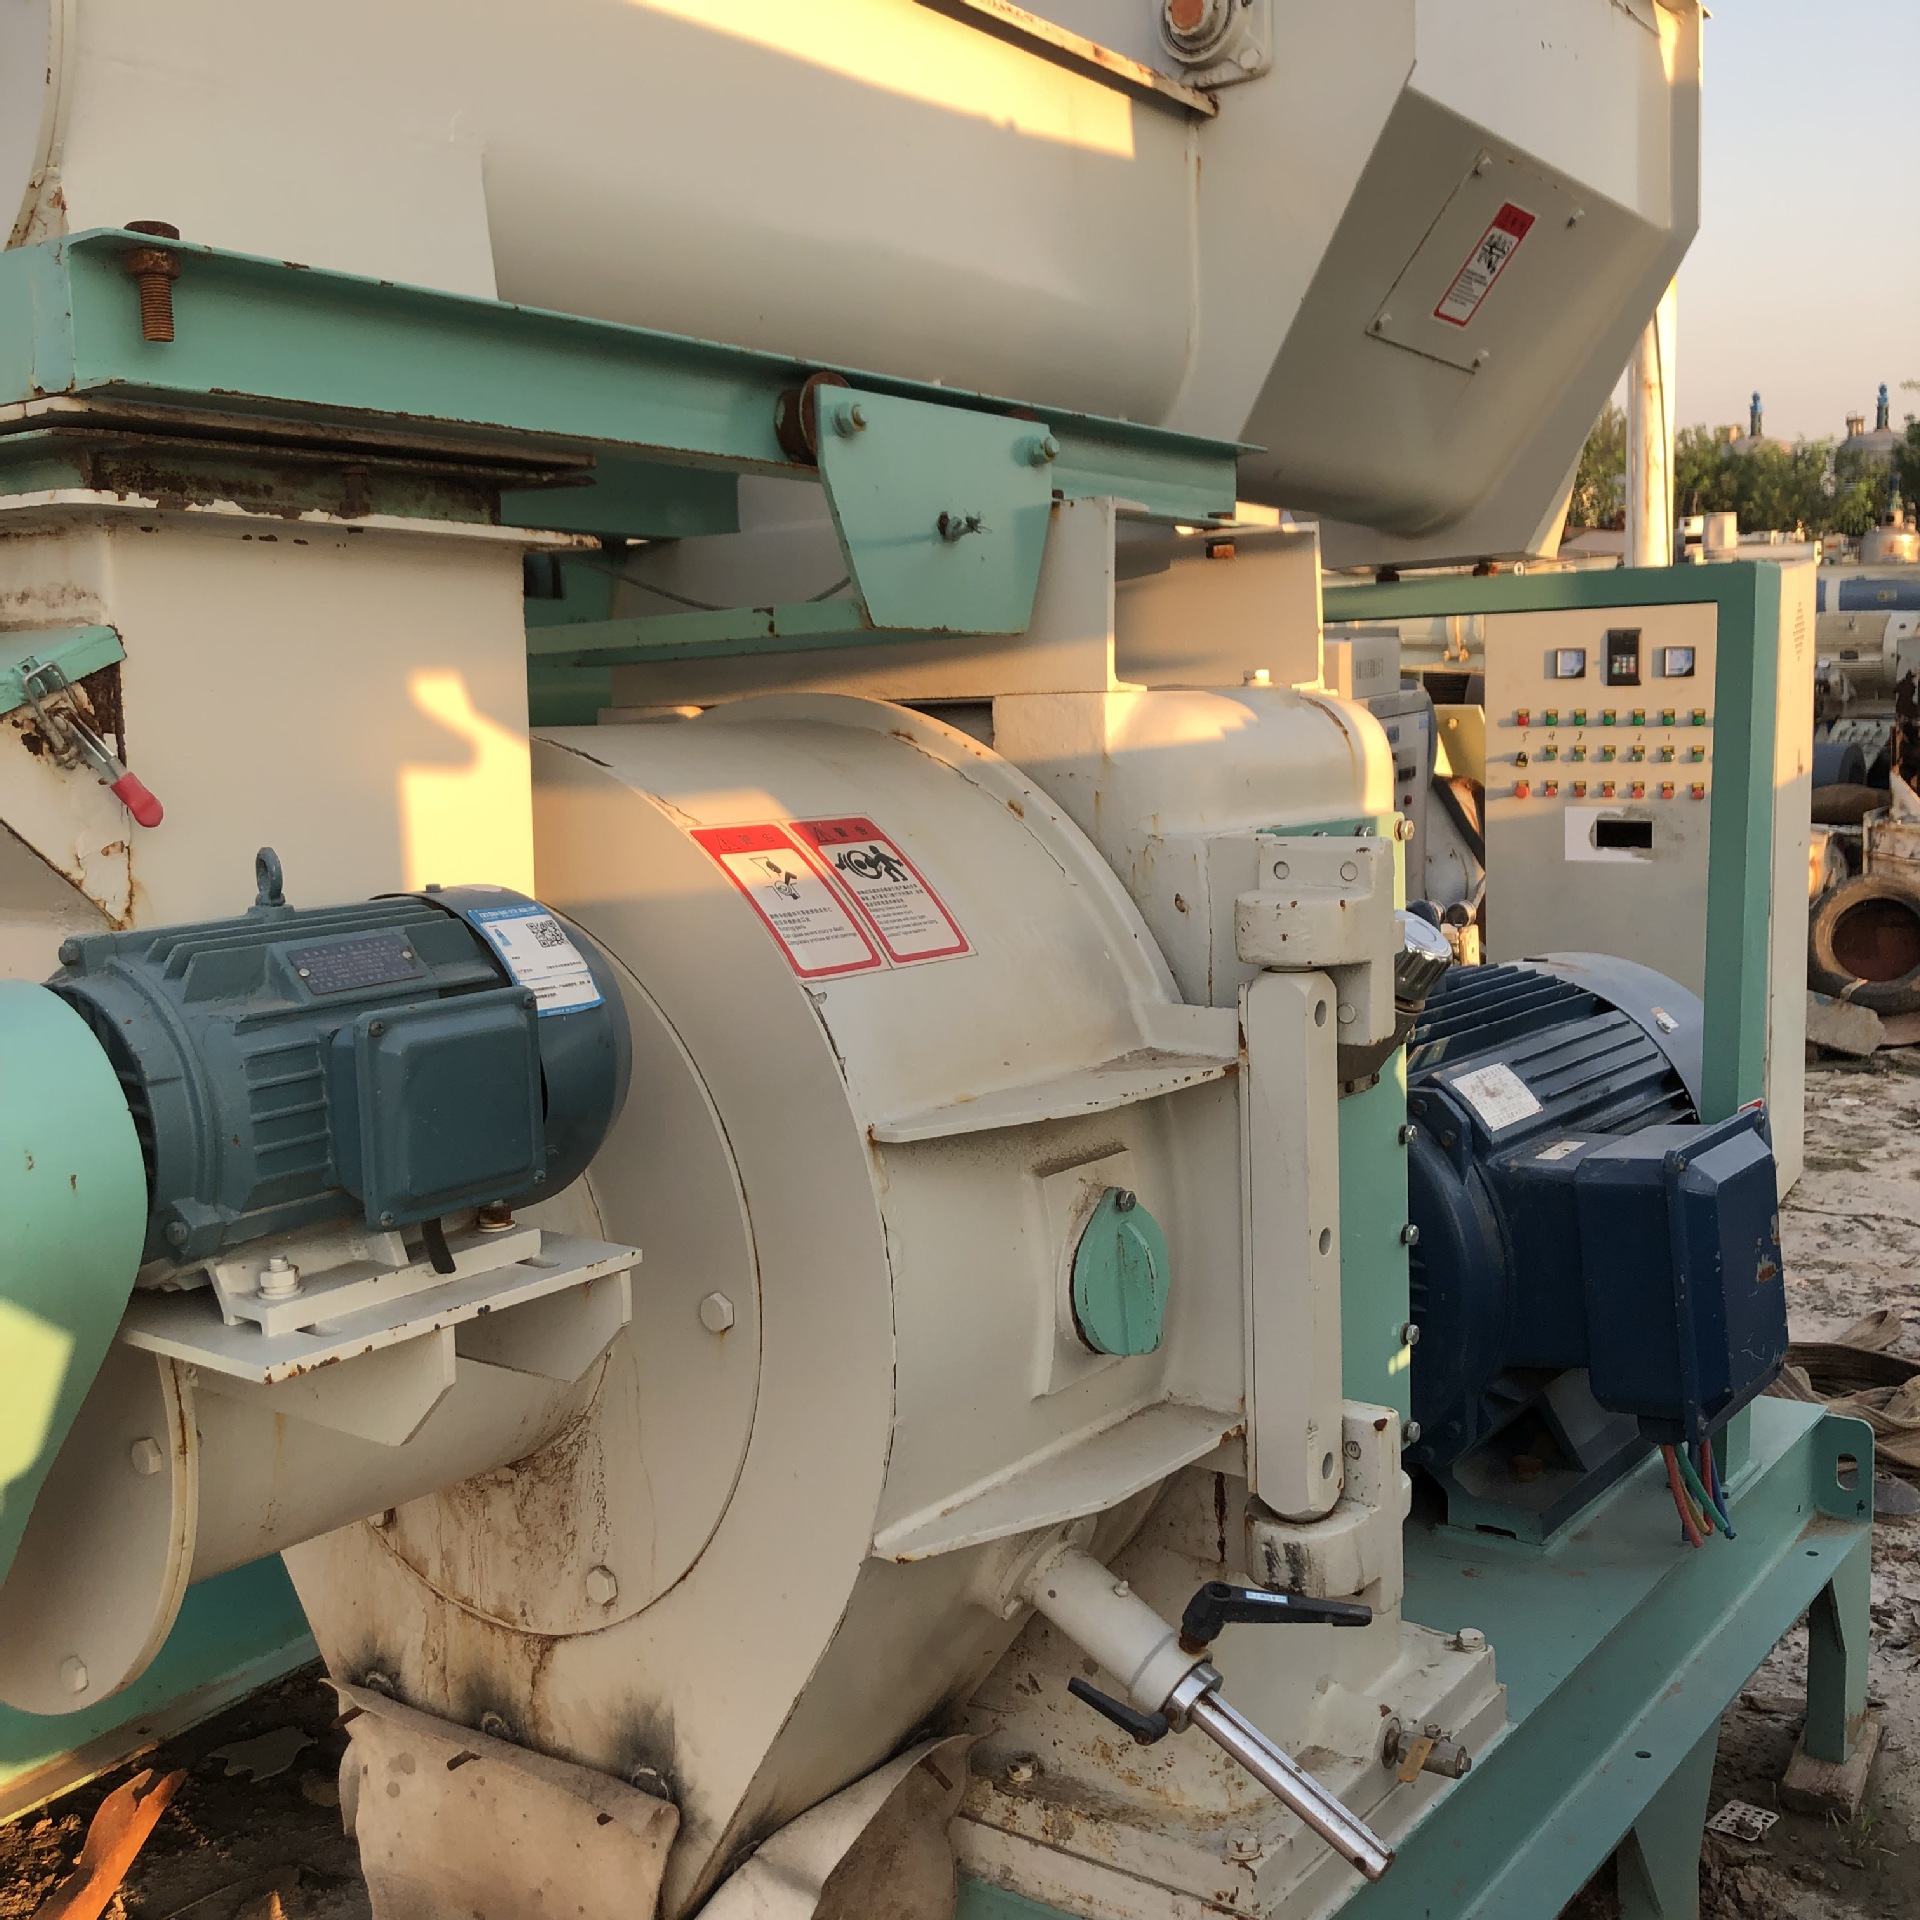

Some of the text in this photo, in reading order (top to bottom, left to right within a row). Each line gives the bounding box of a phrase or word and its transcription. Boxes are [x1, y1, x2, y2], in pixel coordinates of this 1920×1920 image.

[1522, 730, 1530, 742] 5
[1548, 730, 1556, 741] 4
[1576, 730, 1584, 741] 3
